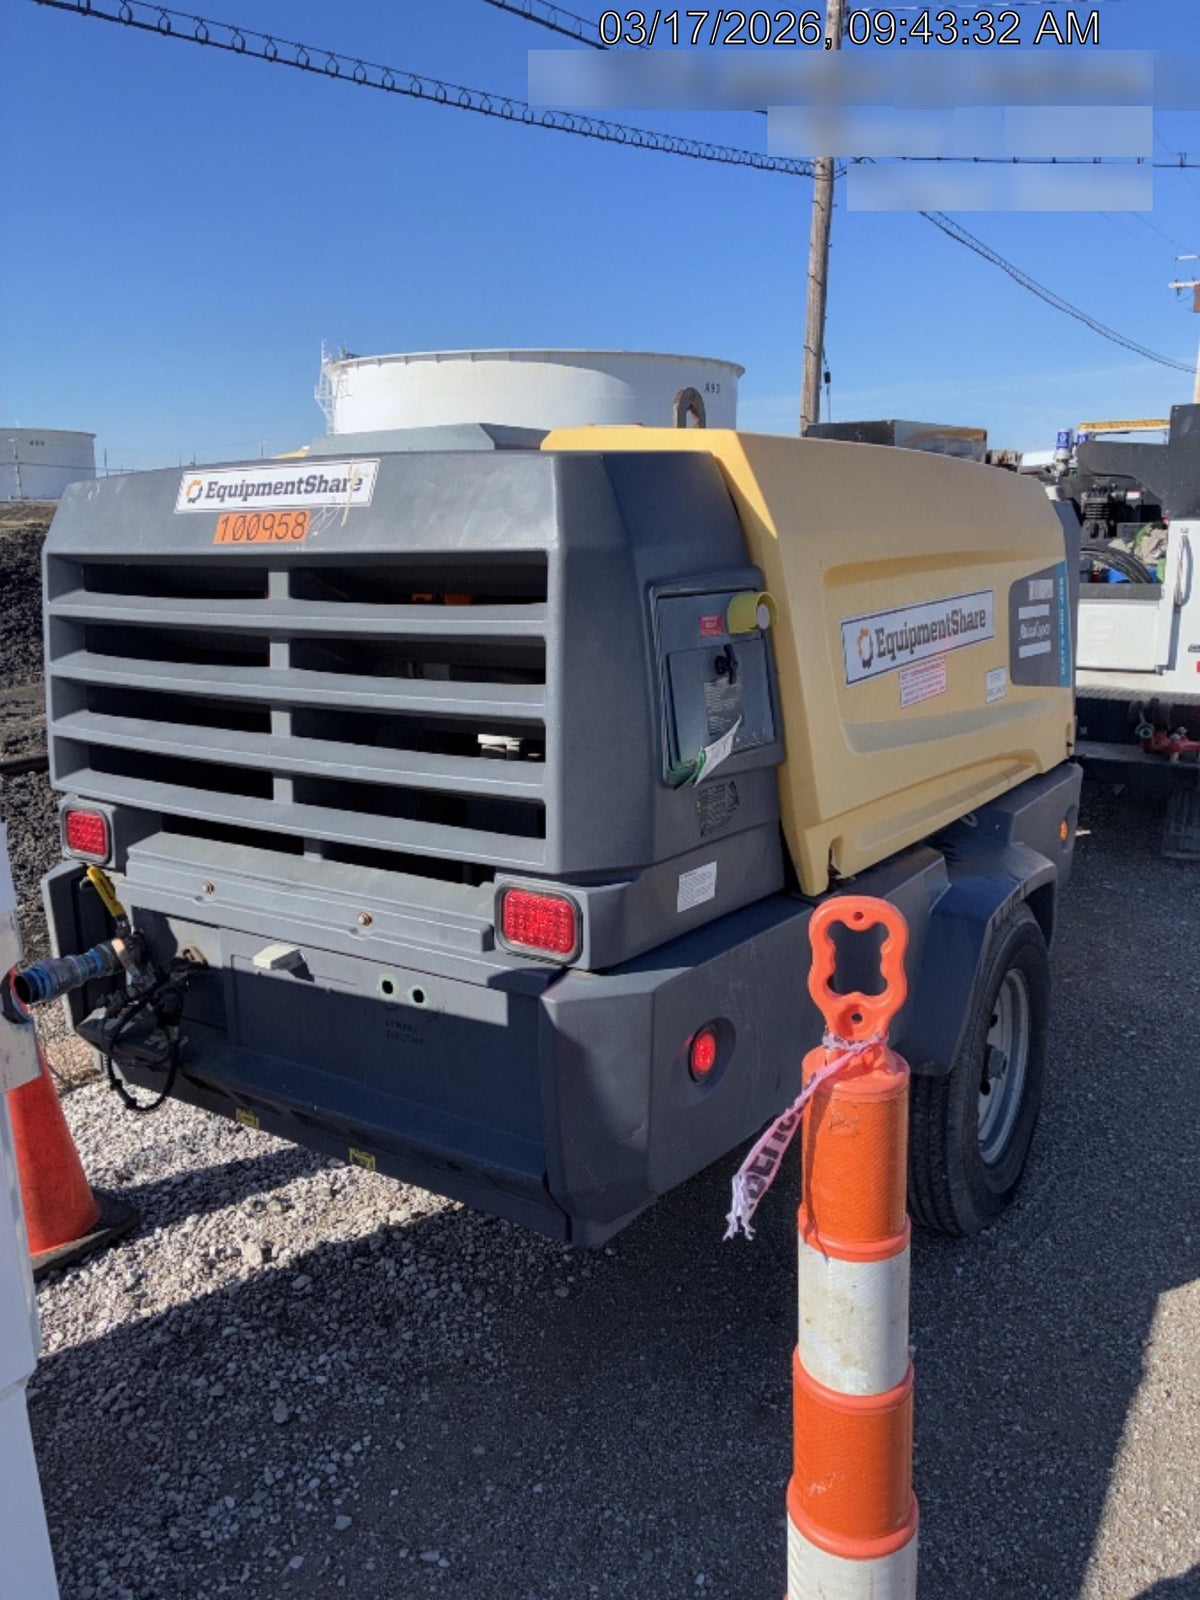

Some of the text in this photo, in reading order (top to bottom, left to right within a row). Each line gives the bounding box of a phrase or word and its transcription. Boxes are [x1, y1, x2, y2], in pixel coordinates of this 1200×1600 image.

[204, 474, 363, 502] EquipmentShare
[220, 511, 307, 542] 100958
[874, 607, 986, 662] EquipmentShare
